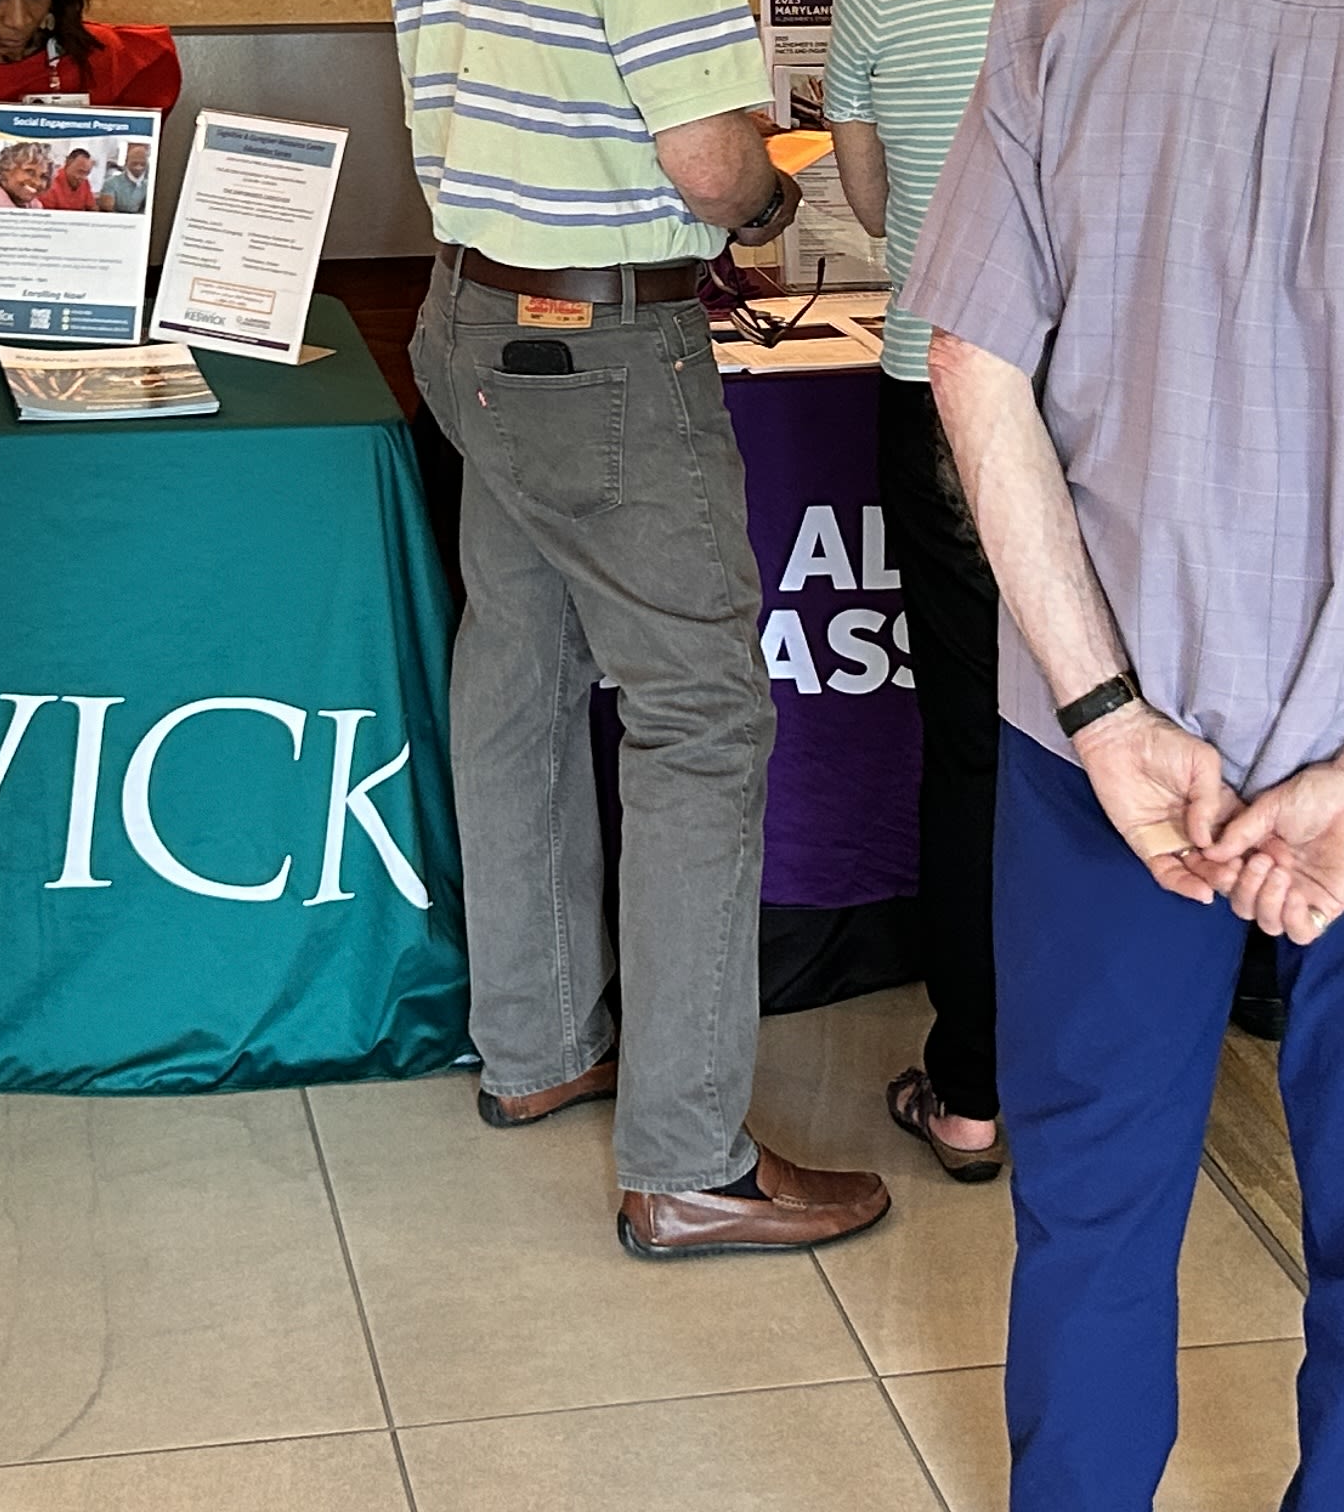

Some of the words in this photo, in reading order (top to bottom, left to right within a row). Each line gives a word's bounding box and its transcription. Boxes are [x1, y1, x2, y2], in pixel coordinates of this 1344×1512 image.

[13, 116, 39, 126] Social
[40, 118, 91, 130] Engagement
[93, 120, 129, 132] Program
[22, 289, 61, 300] Enrolling
